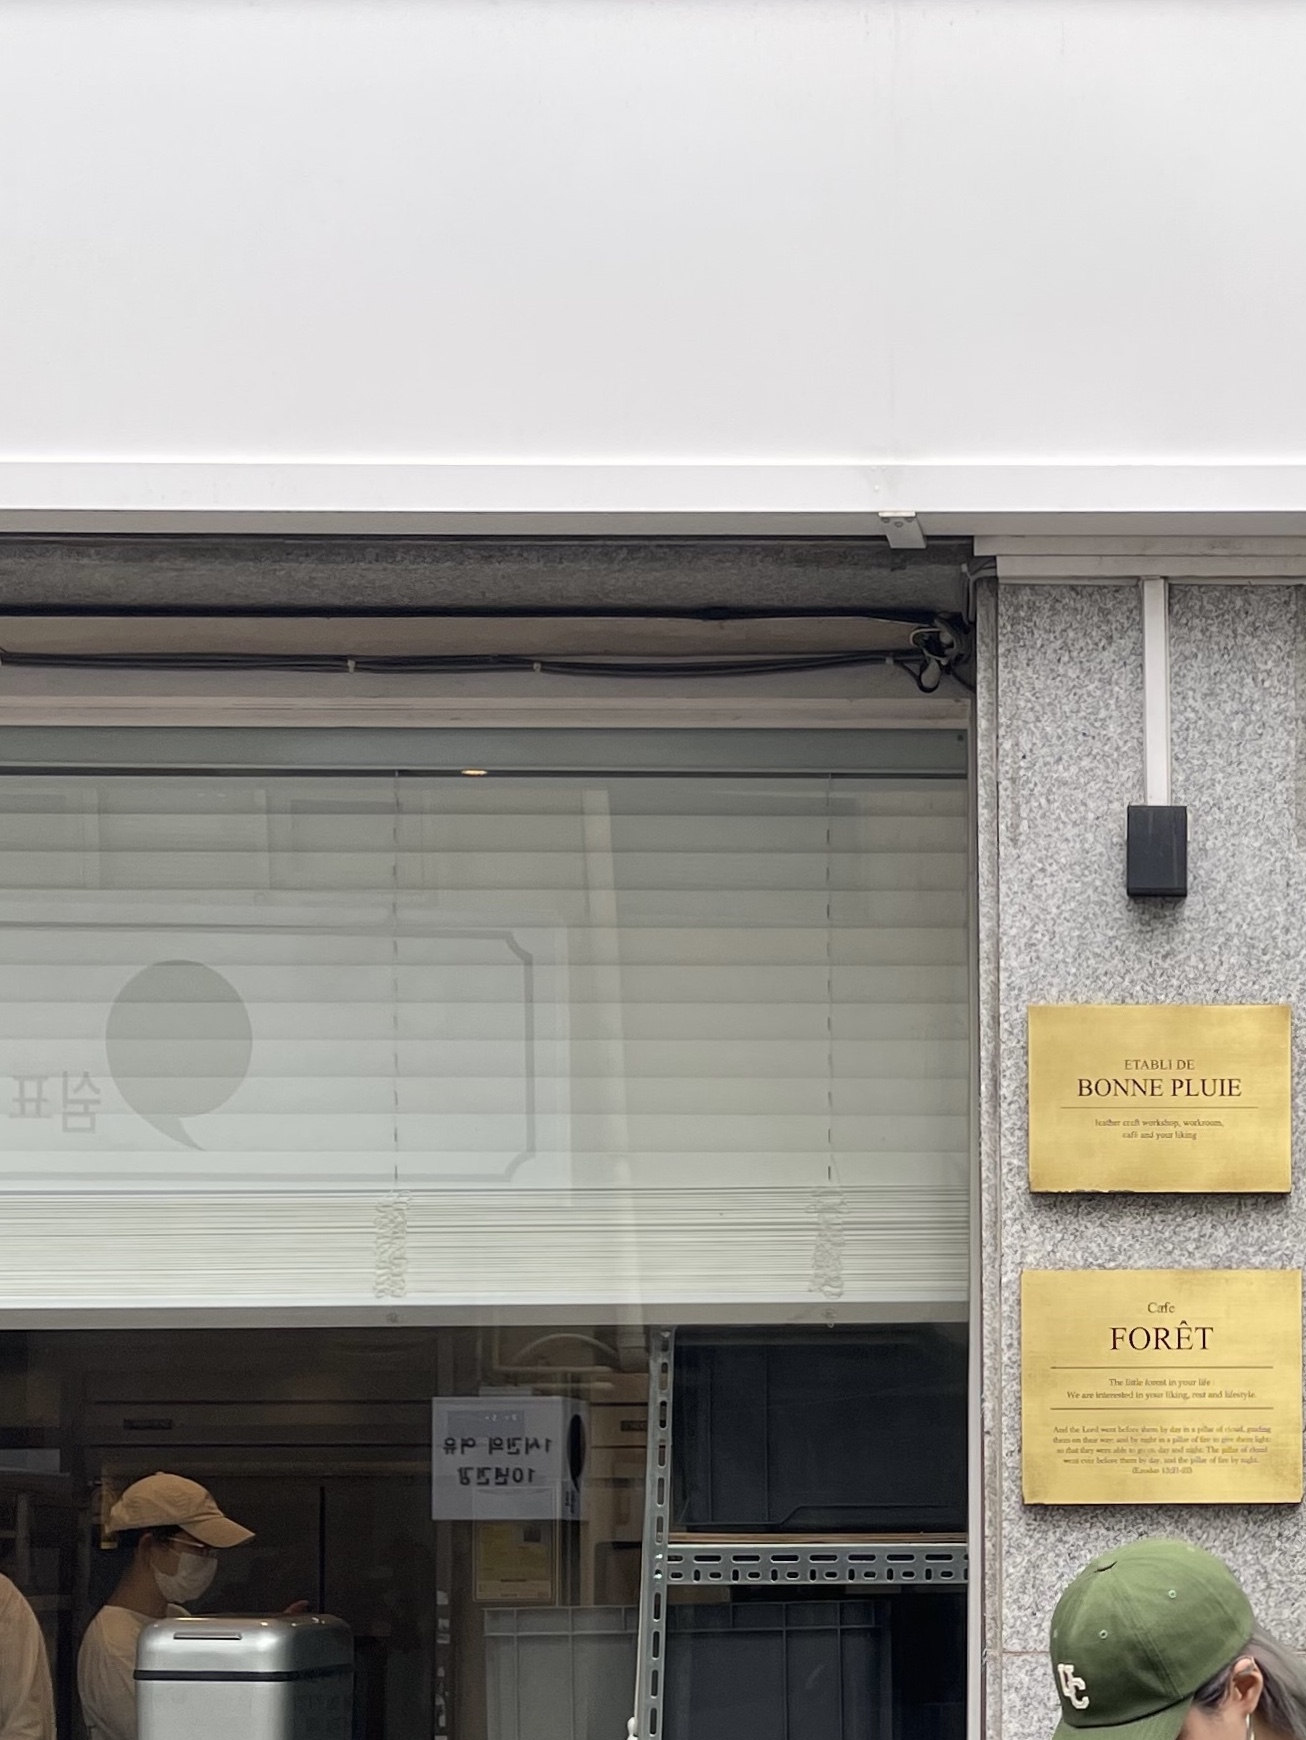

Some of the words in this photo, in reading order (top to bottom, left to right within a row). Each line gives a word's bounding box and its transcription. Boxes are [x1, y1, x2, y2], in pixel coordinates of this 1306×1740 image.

[1124, 1059, 1172, 1070] ETABLI
[1176, 1059, 1195, 1070] DE
[1078, 1078, 1164, 1097] BONNE
[1171, 1078, 1242, 1097] PLUIE
[1110, 1320, 1214, 1350] FORÊT
